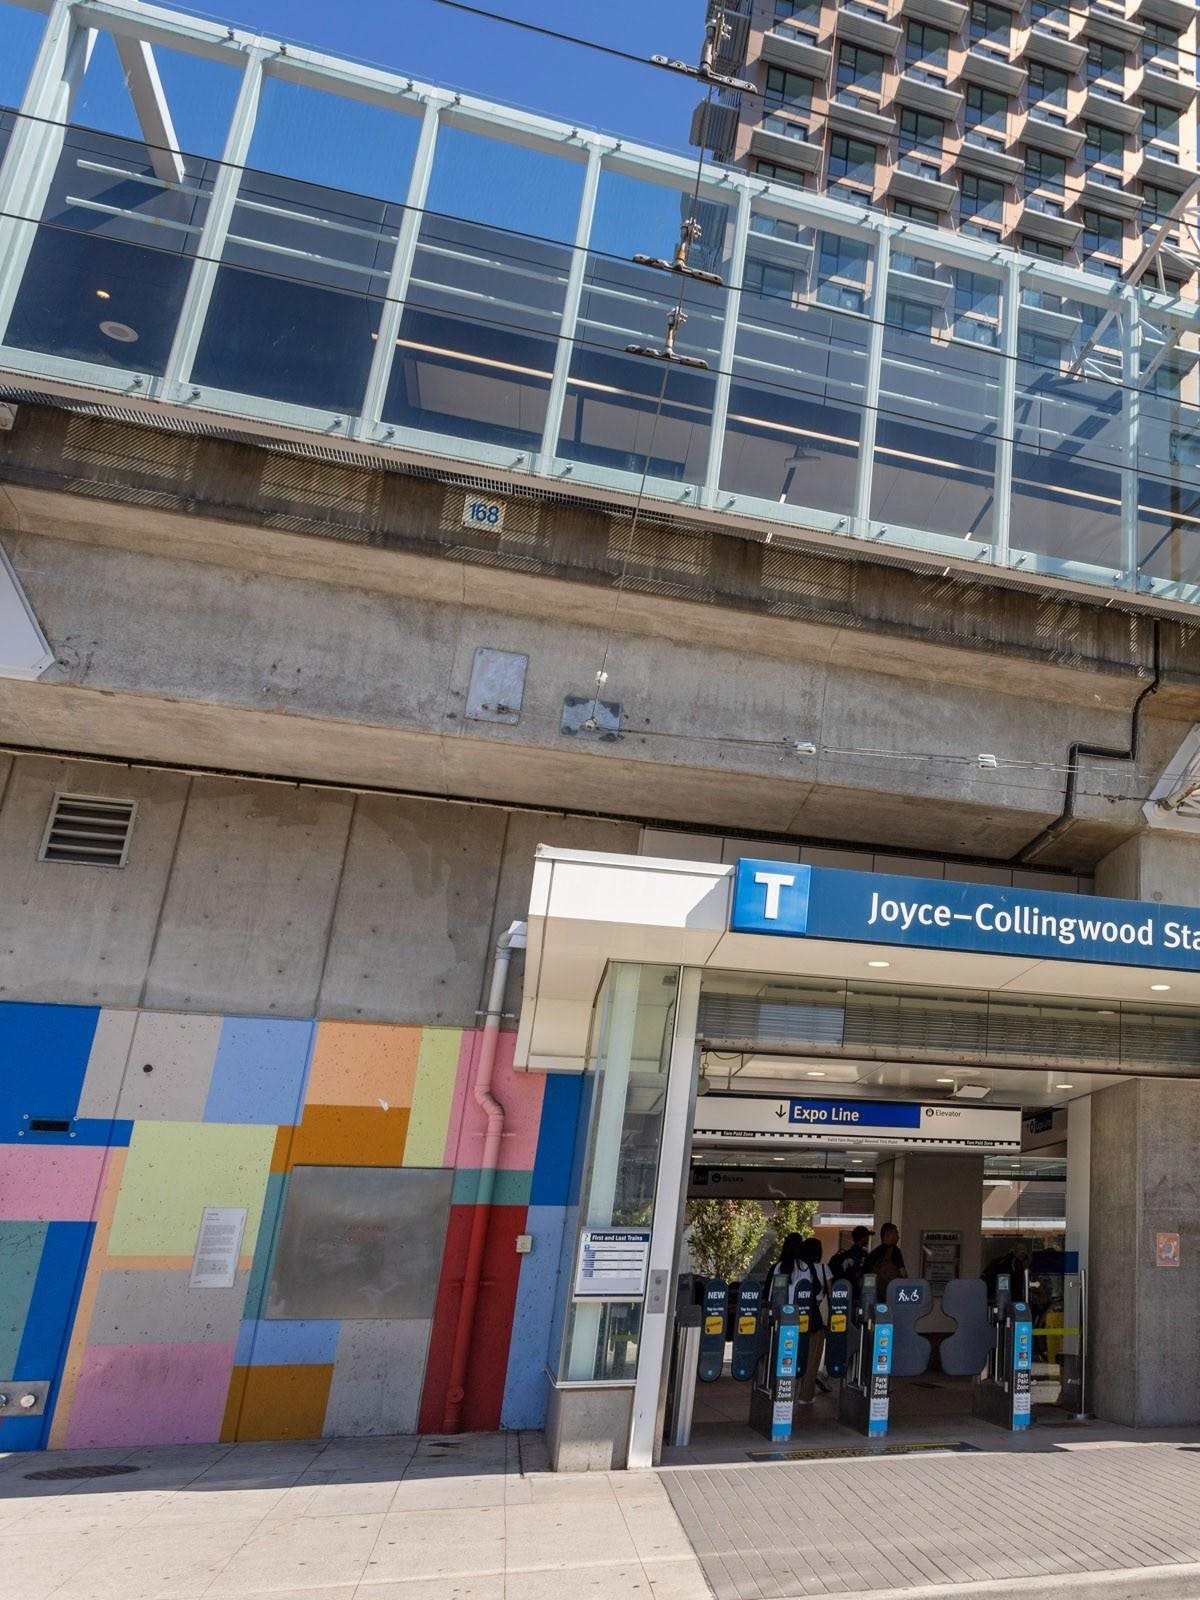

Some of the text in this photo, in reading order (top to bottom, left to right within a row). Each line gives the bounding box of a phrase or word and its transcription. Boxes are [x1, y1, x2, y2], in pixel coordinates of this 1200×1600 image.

[470, 503, 499, 524] 168
[755, 872, 795, 919] T
[793, 1106, 860, 1123] Expo Line
[935, 1109, 962, 1118] Elevator
[708, 1291, 726, 1300] NEW
[741, 1291, 759, 1300] NEW
[798, 1291, 811, 1299] NEW
[832, 1290, 848, 1298] NEW
[777, 1391, 791, 1399] Zone
